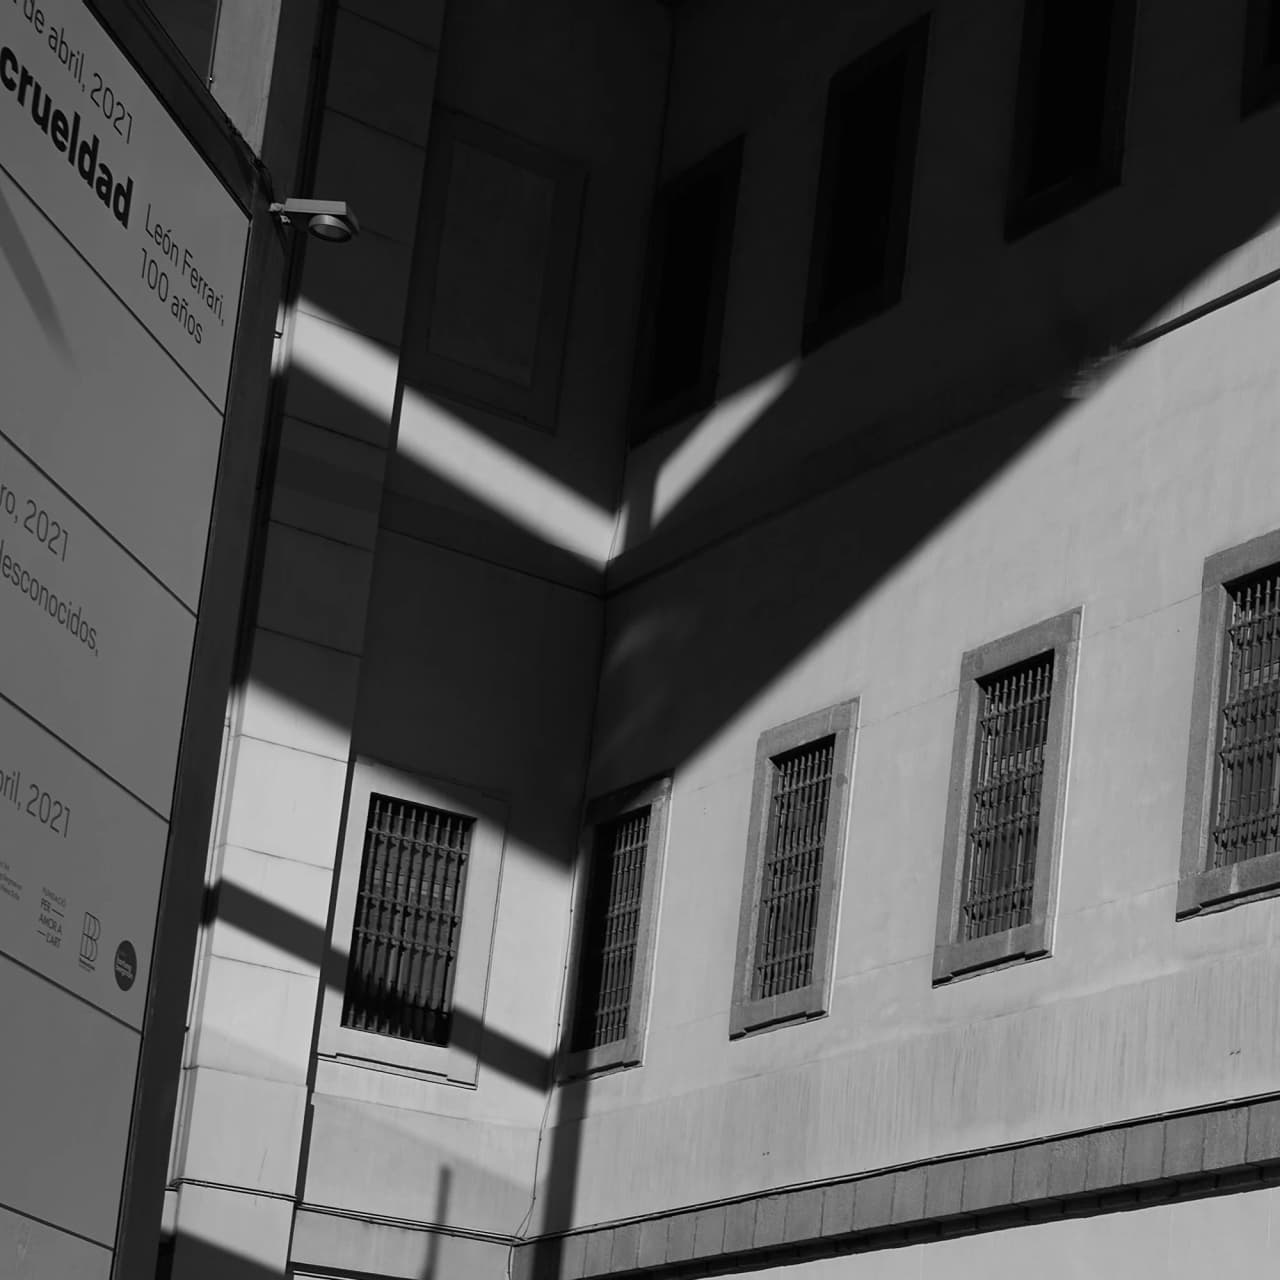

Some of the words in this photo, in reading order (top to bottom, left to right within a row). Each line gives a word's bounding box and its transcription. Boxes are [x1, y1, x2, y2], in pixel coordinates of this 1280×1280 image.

[0, 46, 134, 229] crueldad
[48, 27, 85, 93] abril,
[90, 73, 133, 144] 2021
[141, 248, 169, 303] 100
[171, 297, 203, 344] años
[145, 203, 180, 267] León
[181, 249, 225, 326] Ferrari,
[23, 499, 69, 562] 2021
[26, 784, 71, 838] 2021
